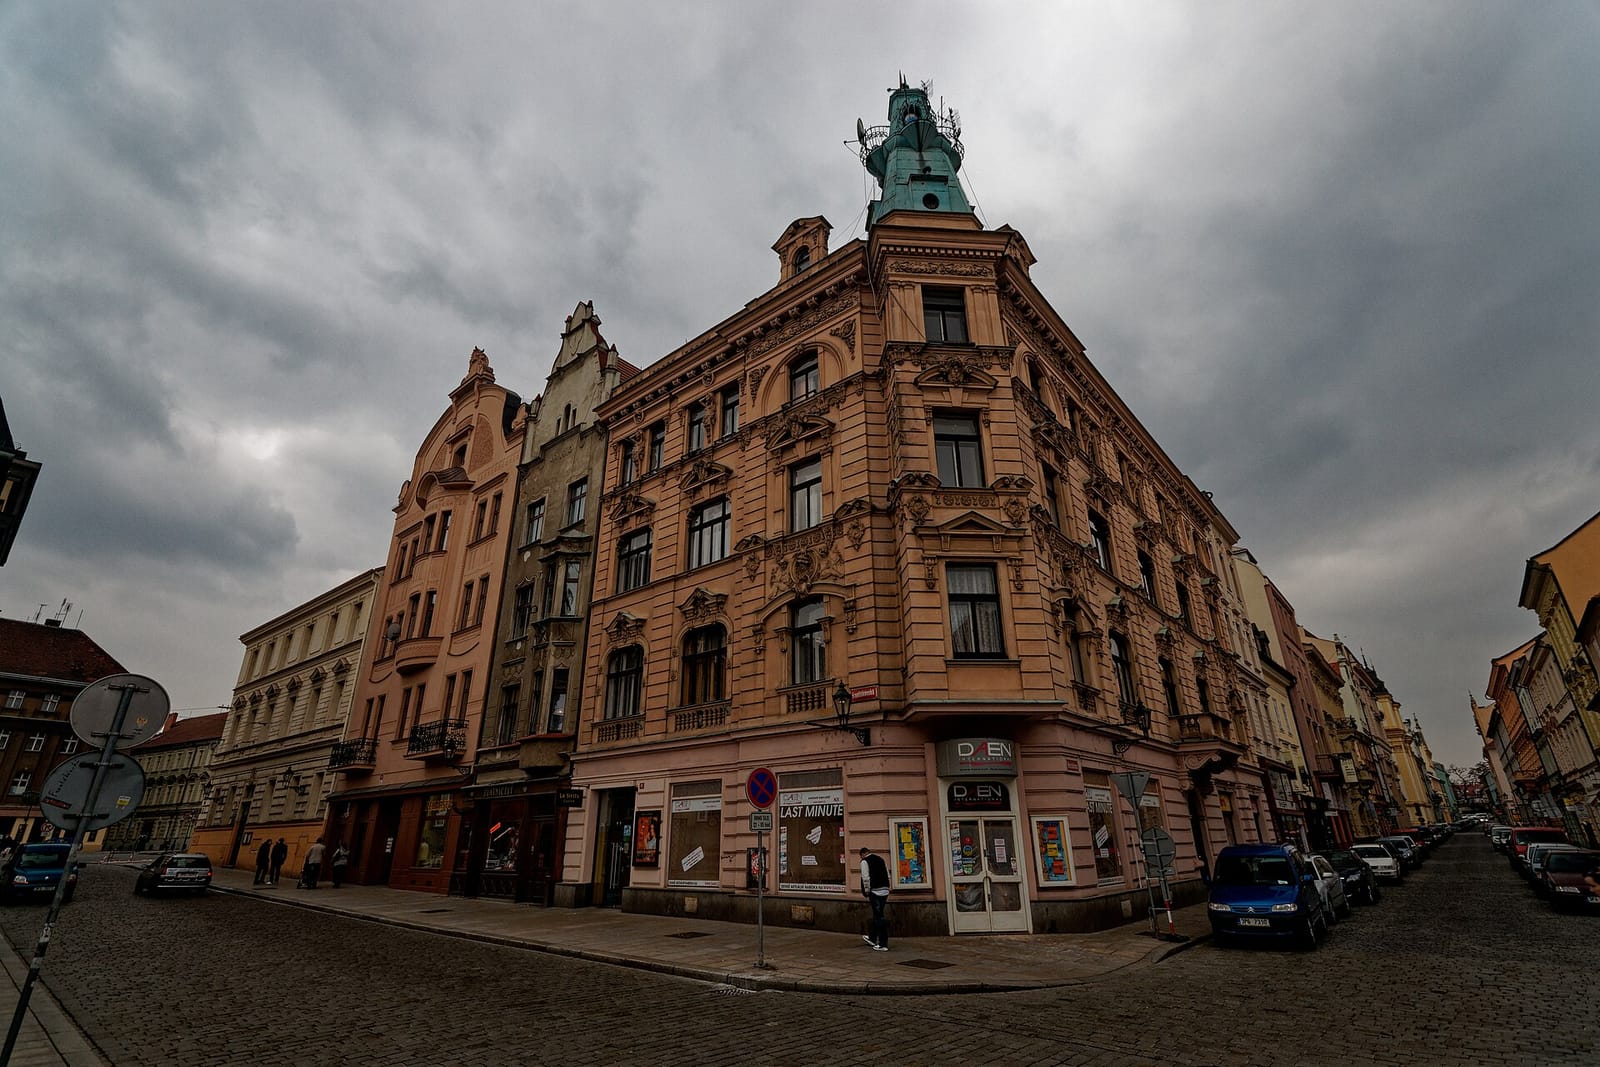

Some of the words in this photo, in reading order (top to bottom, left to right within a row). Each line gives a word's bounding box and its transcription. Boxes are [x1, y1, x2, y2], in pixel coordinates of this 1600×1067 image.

[958, 741, 1012, 758] DAEN
[780, 806, 803, 818] LAST
[805, 804, 844, 817] MINUTE
